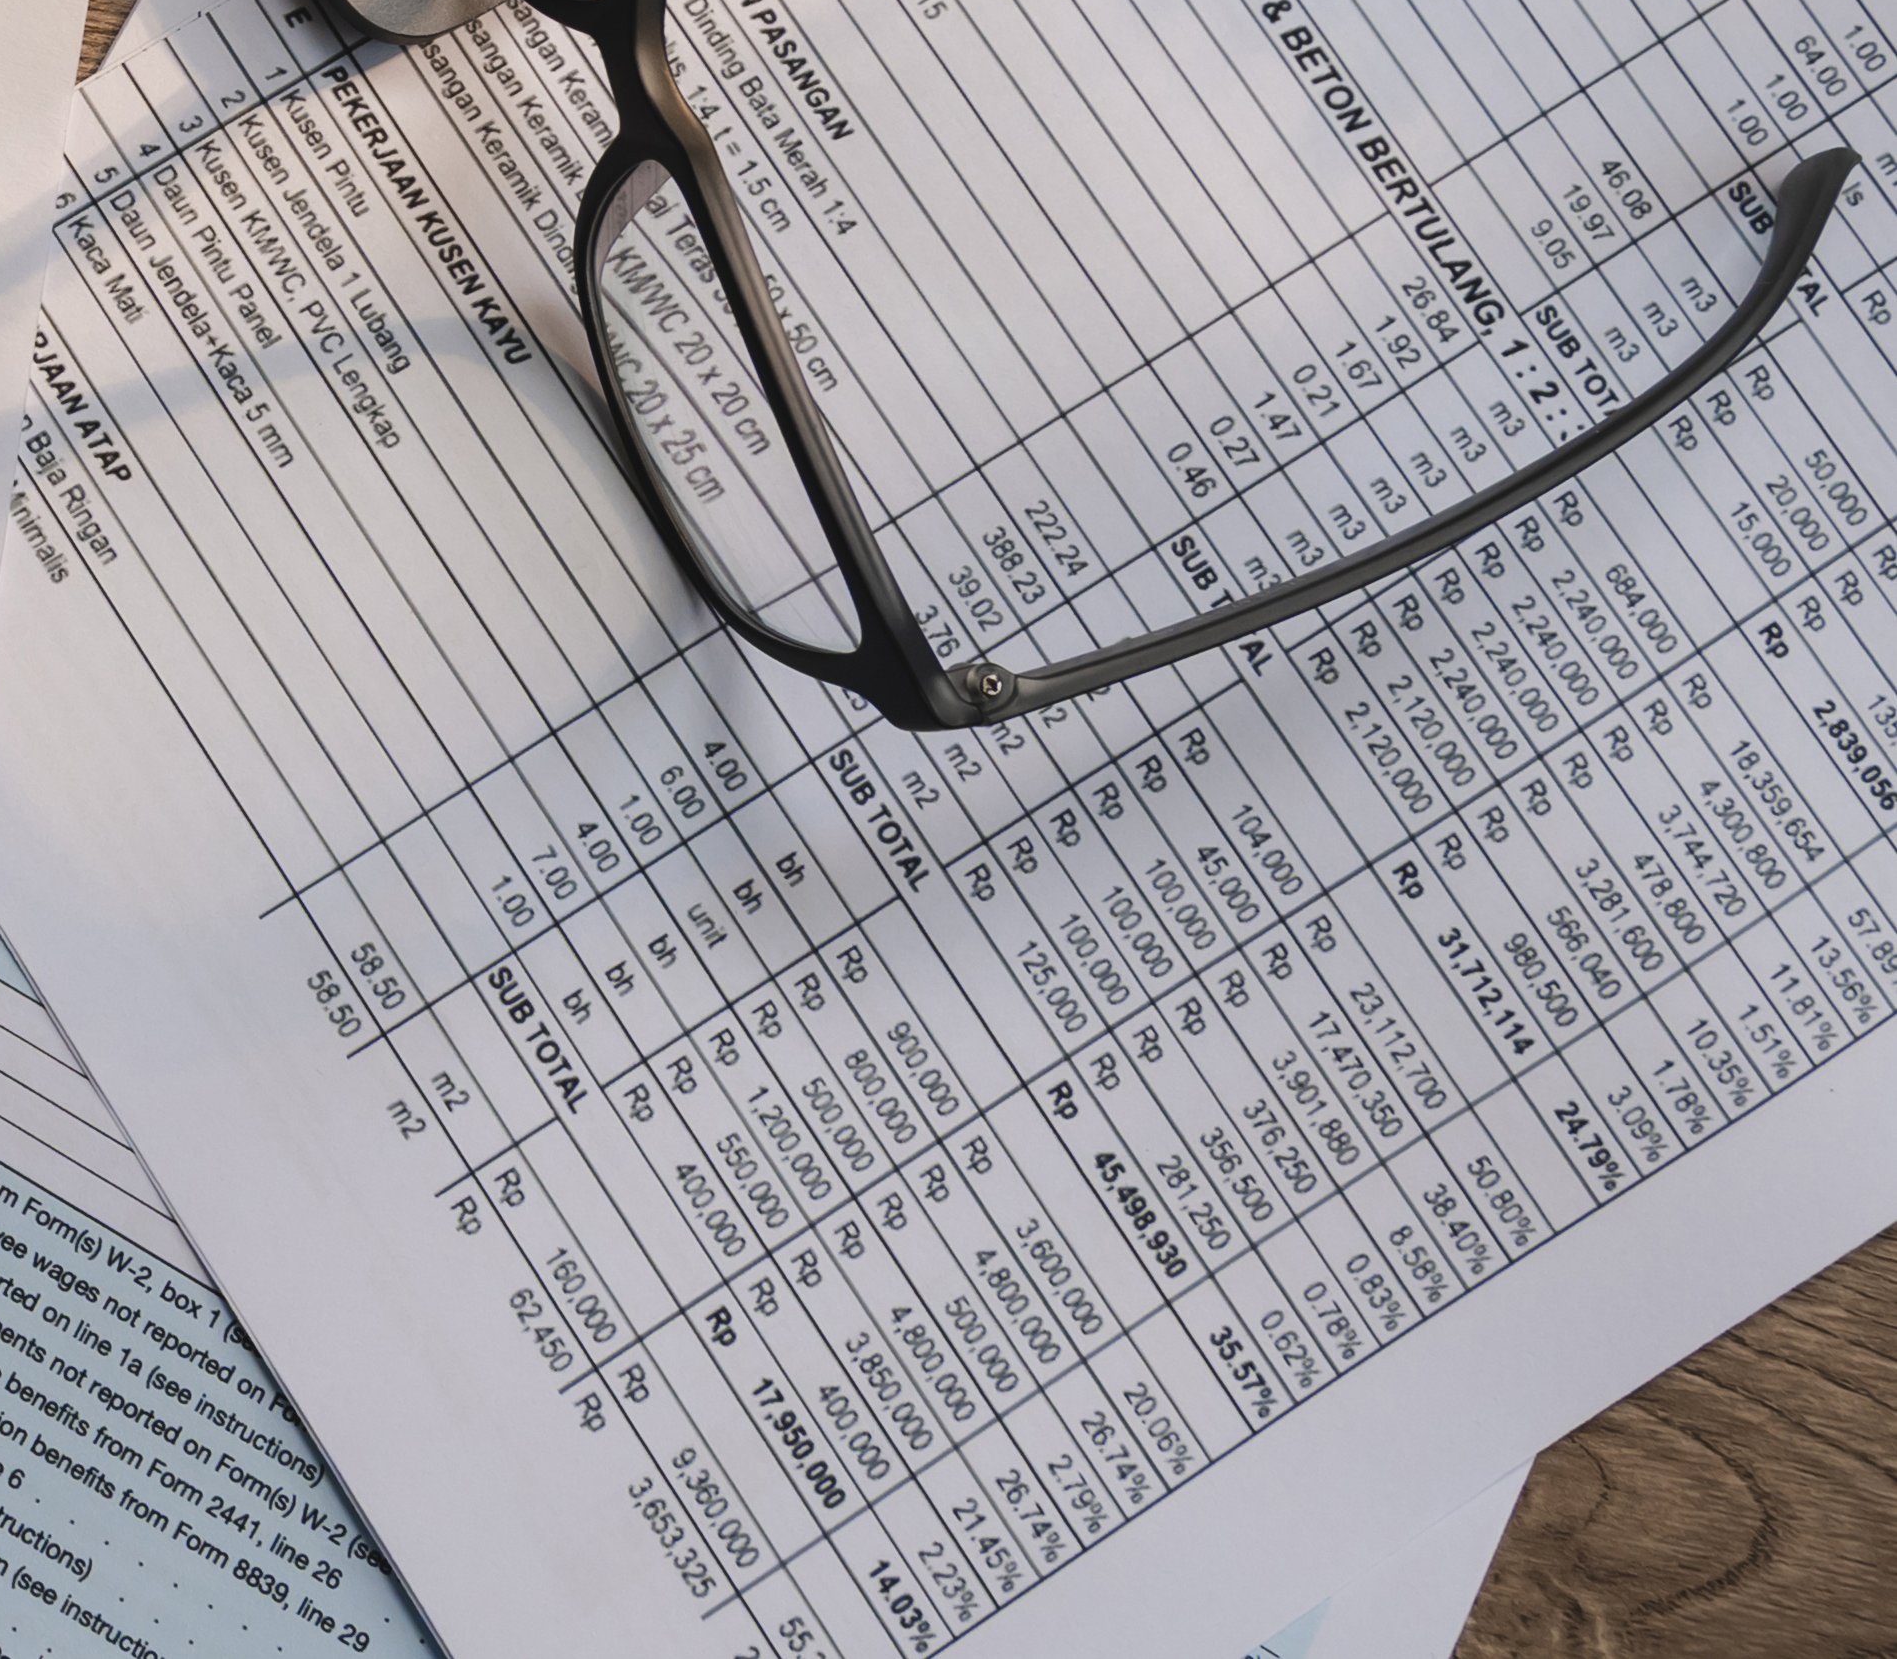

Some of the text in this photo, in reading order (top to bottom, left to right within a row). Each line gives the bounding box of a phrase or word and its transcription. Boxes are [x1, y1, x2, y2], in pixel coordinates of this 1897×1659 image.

[278, 87, 369, 218] Kusen Pintu
[1602, 161, 1653, 220] 46.08
[320, 64, 533, 365] PEKERJAAN KUSEN KAYU
[66, 215, 143, 323] Kaca Mati
[1401, 276, 1460, 343] 26.84
[828, 746, 928, 893] SUB TOTAL
[1438, 927, 1535, 1055] 31,712,114
[1554, 1100, 1622, 1192] 24.79%
[1095, 1153, 1187, 1279] 45,498,930
[1467, 1155, 1537, 1248] 50.80%
[509, 1288, 574, 1372] 62,450
[546, 1247, 617, 1344] 160,000
